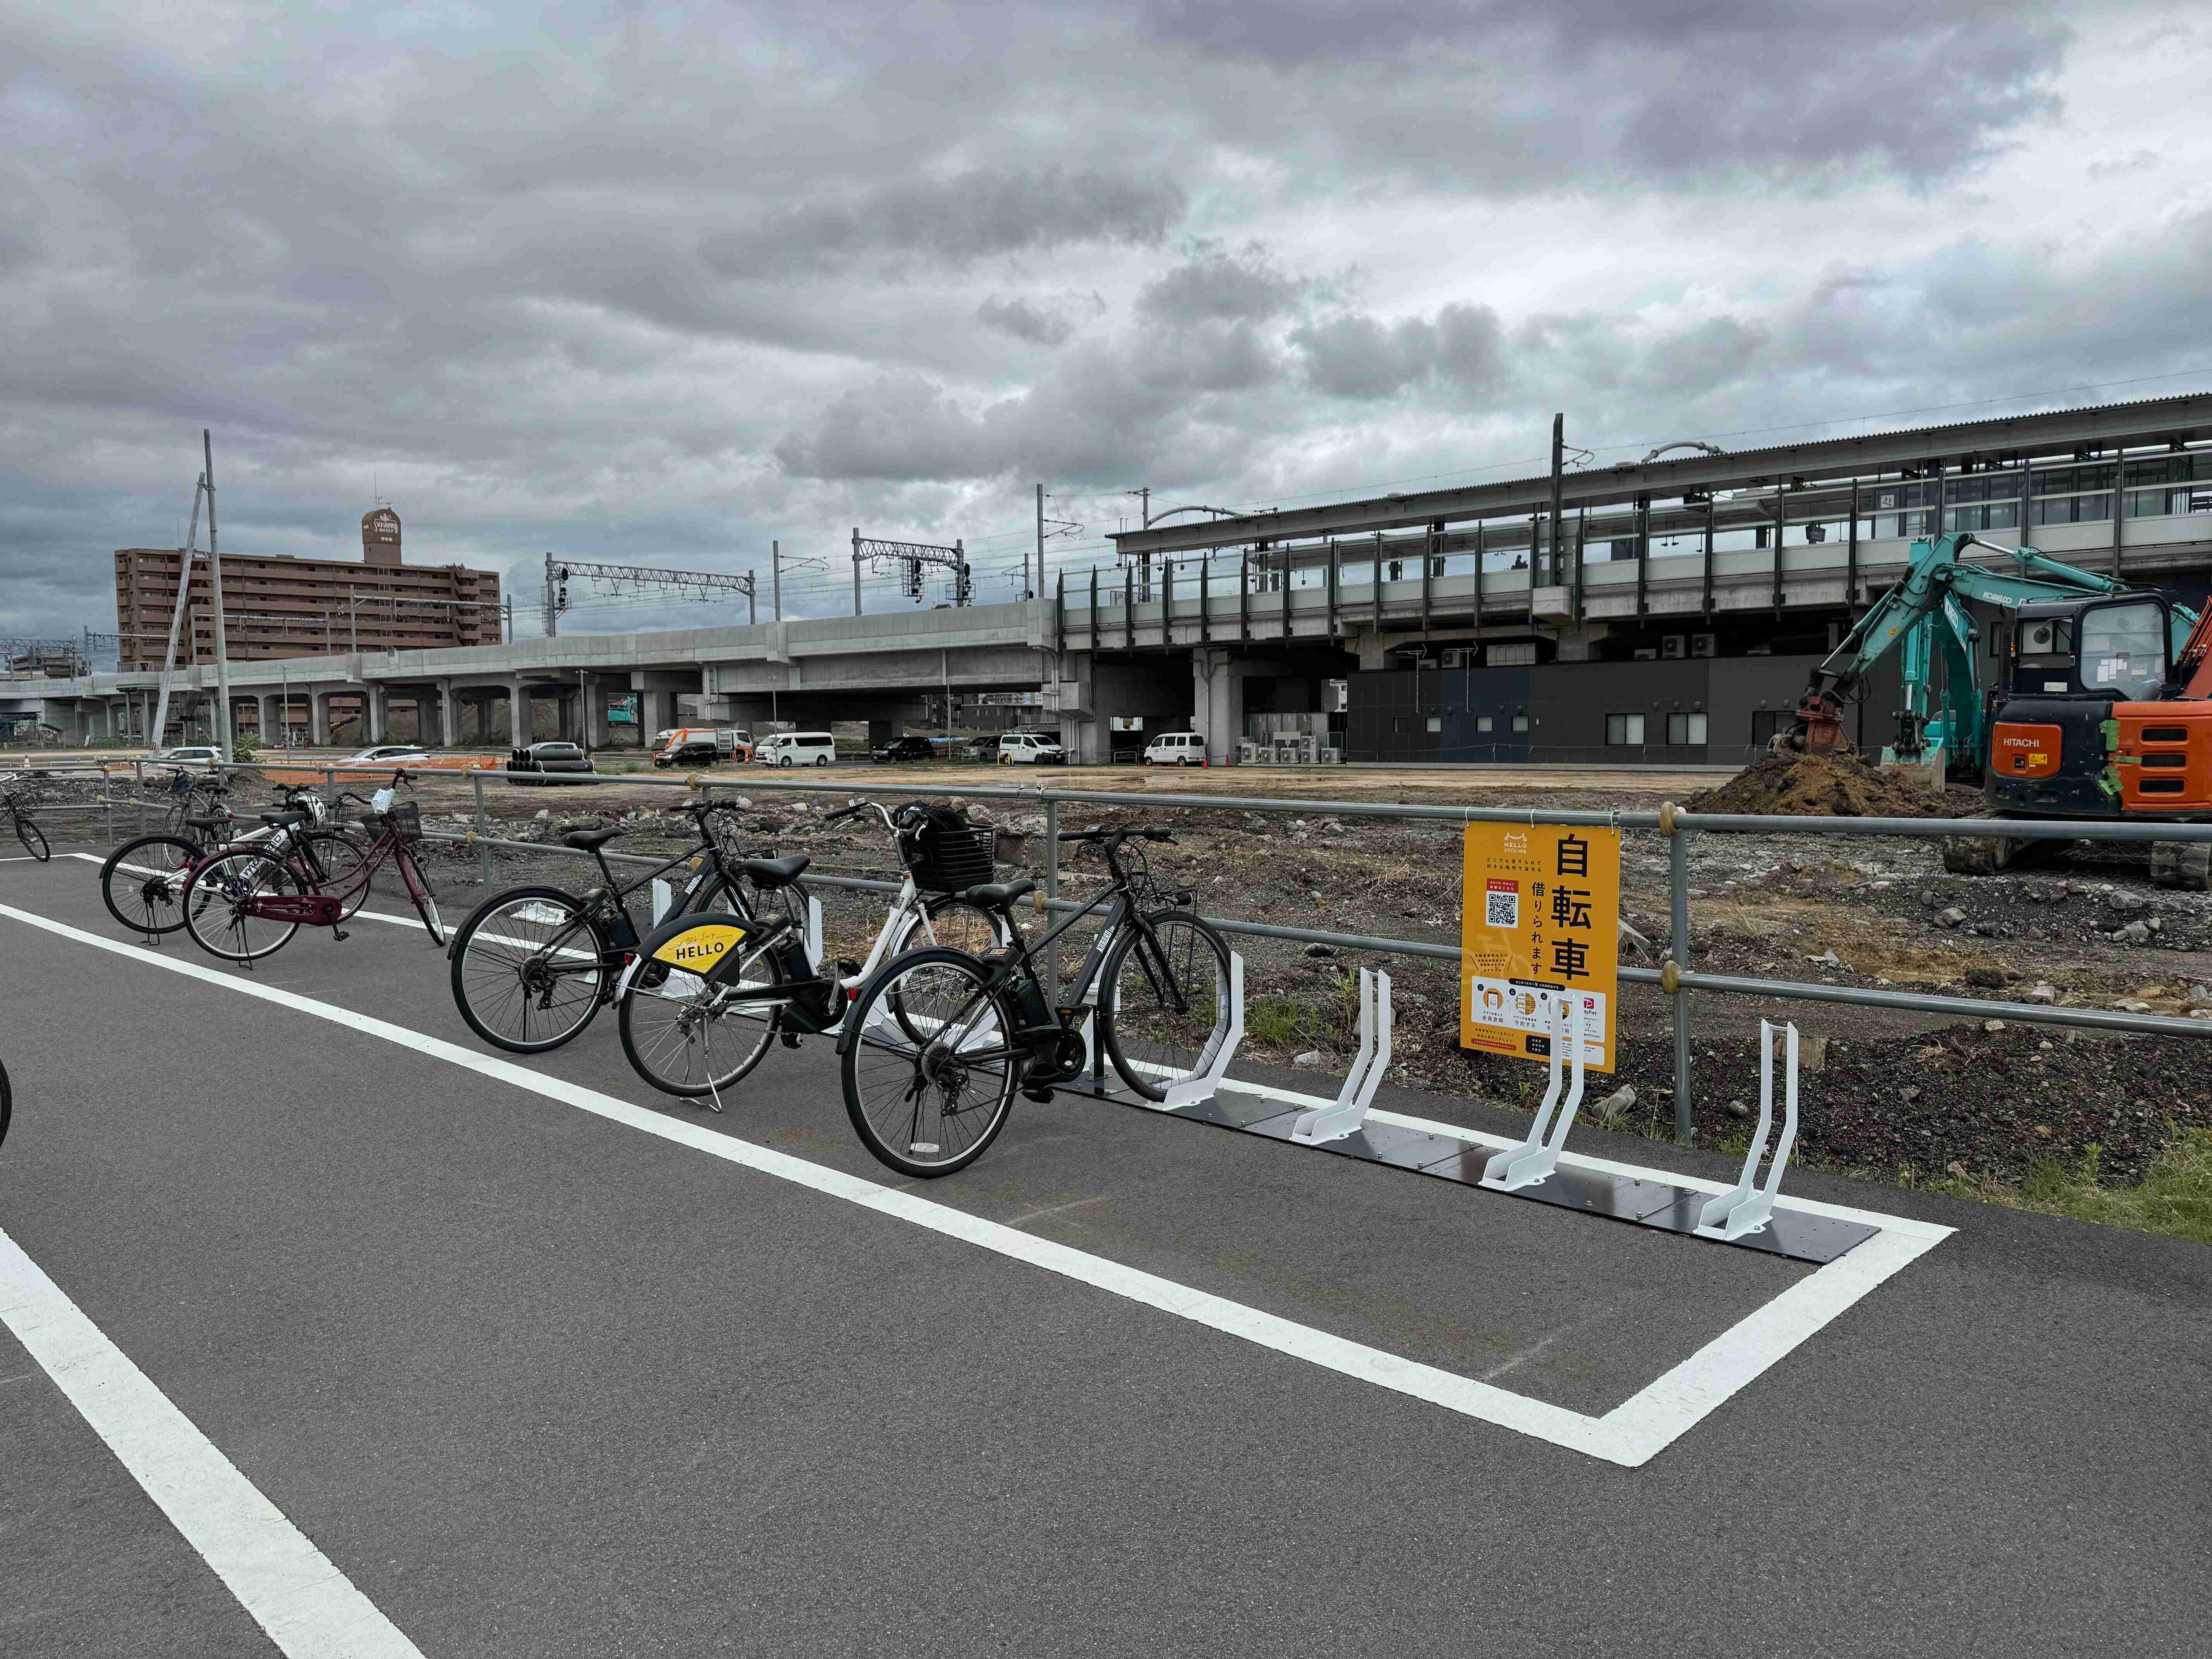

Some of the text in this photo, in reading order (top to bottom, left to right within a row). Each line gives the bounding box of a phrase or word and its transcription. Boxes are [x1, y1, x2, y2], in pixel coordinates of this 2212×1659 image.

[1983, 591, 2012, 604] KOBELCO
[2004, 738, 2039, 747] HITACHI
[1550, 833, 1592, 980] 自転車
[1531, 881, 1545, 975] 借りられます
[676, 942, 724, 960] HELLO
[1515, 1020, 1536, 1028] 予約する
